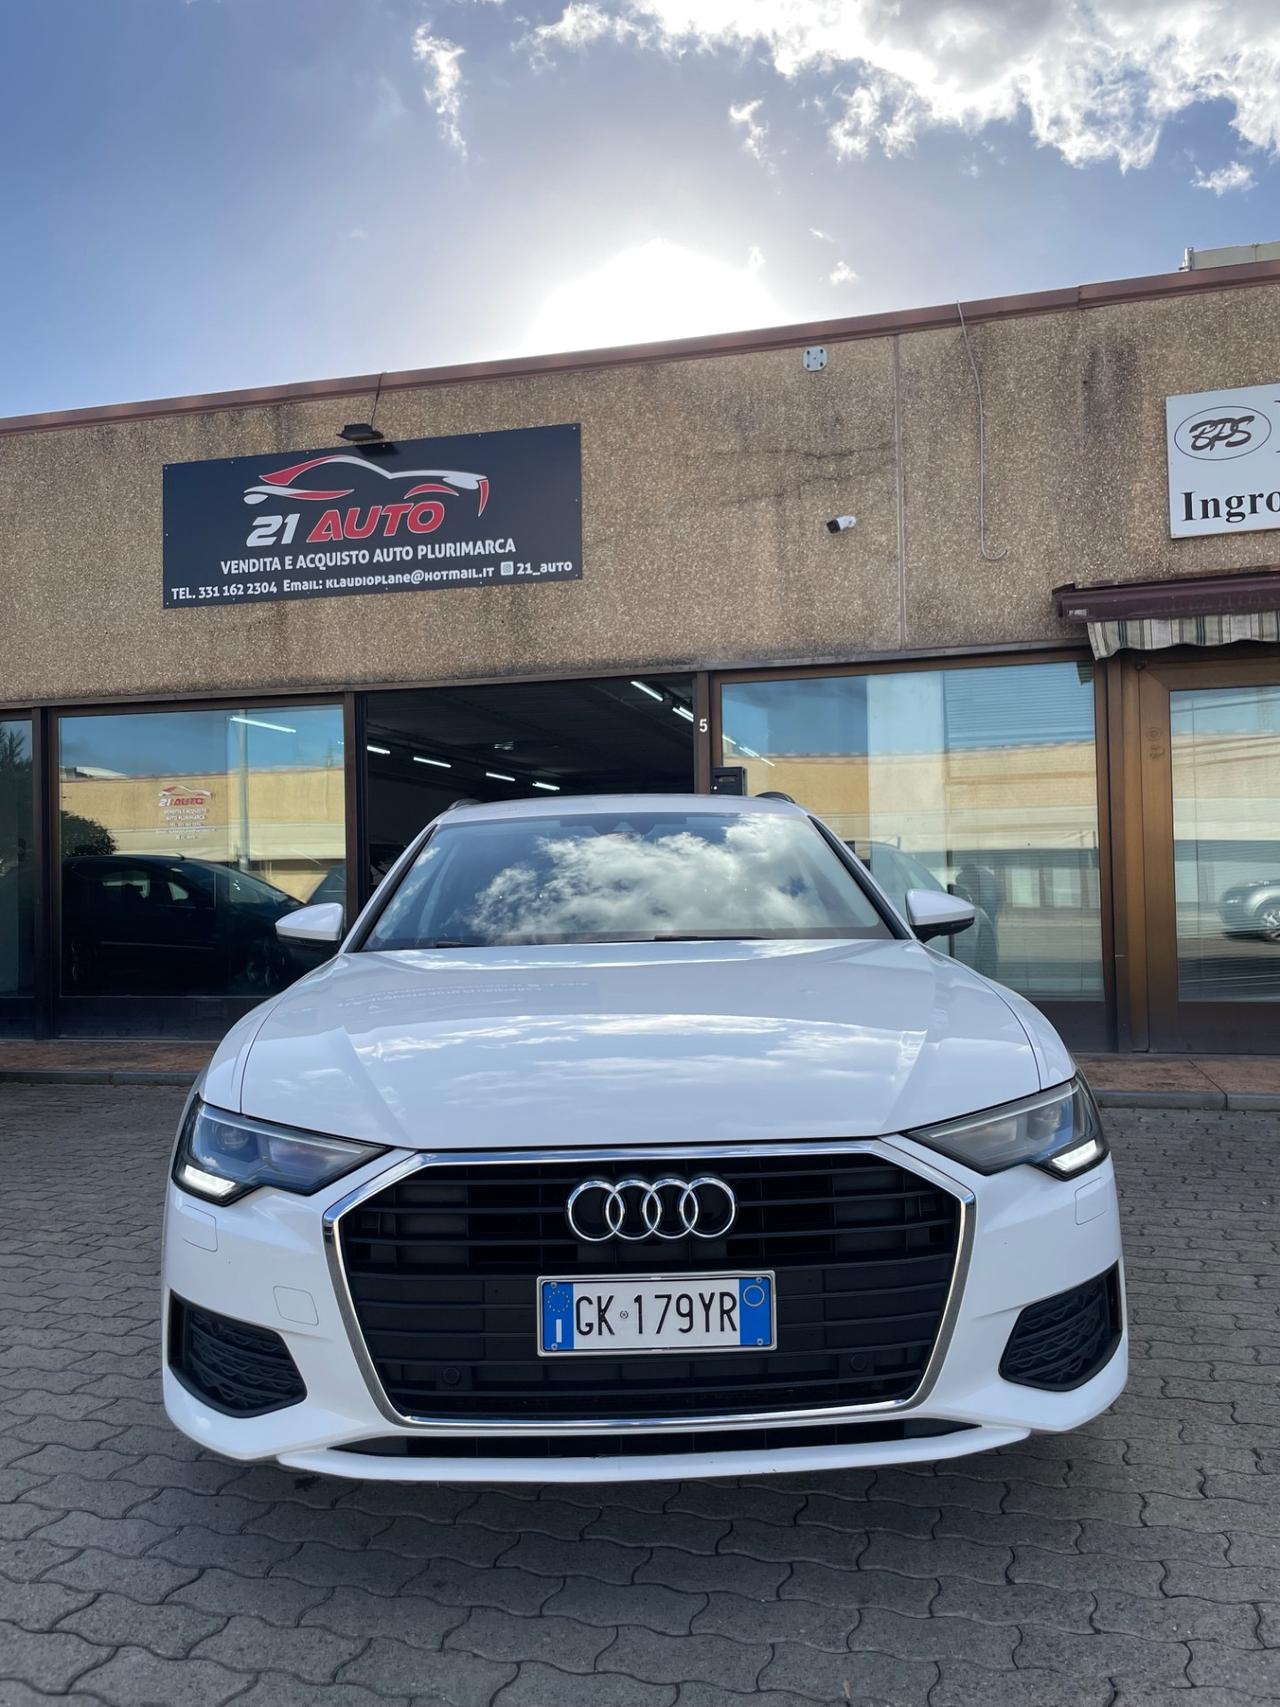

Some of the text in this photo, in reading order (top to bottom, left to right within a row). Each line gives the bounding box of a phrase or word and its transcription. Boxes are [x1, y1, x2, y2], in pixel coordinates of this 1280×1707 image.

[246, 501, 445, 547] 21 AUTO
[220, 537, 517, 576] VENDITA E ACQUISTO AUTO PLURIMARCA
[171, 587, 196, 600] TEL.
[198, 585, 220, 599] 331
[222, 583, 244, 596] 162
[246, 581, 277, 595] 2304
[699, 718, 708, 733] 5
[555, 1291, 738, 1344] I GK 179YR
